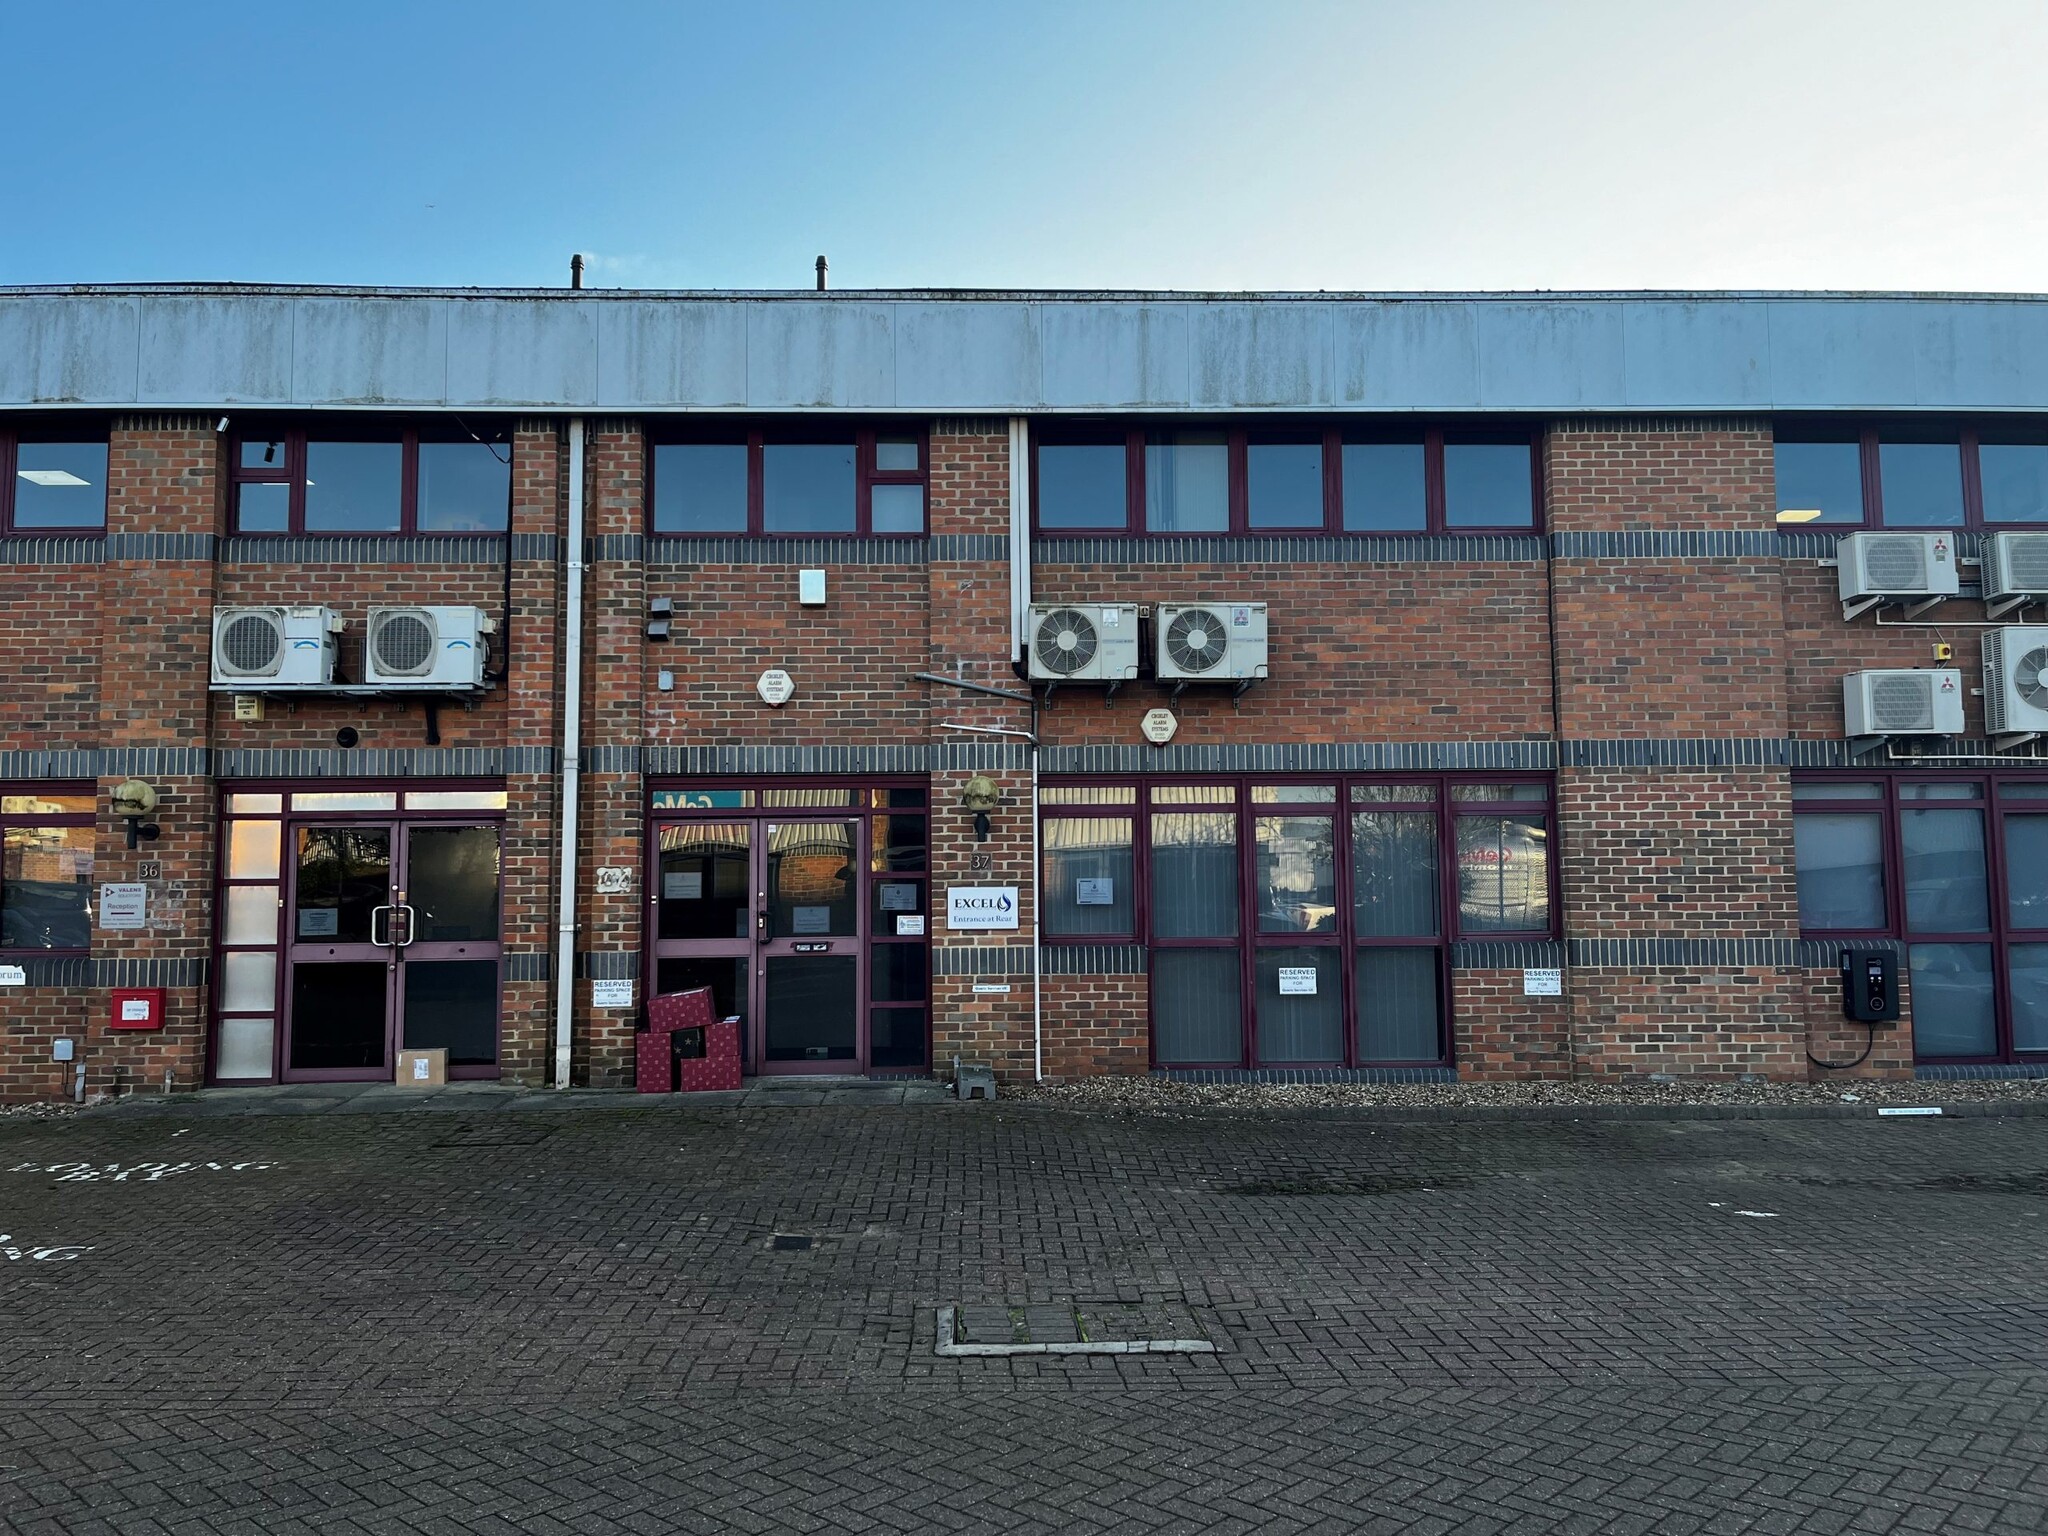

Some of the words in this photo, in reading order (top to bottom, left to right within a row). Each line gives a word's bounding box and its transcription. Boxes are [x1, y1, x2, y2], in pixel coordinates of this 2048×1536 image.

[972, 855, 989, 869] 37
[141, 863, 158, 877] 36
[954, 898, 997, 909] EXCEL
[953, 915, 987, 923] Entrance
[7, 1161, 281, 1173] LOADING
